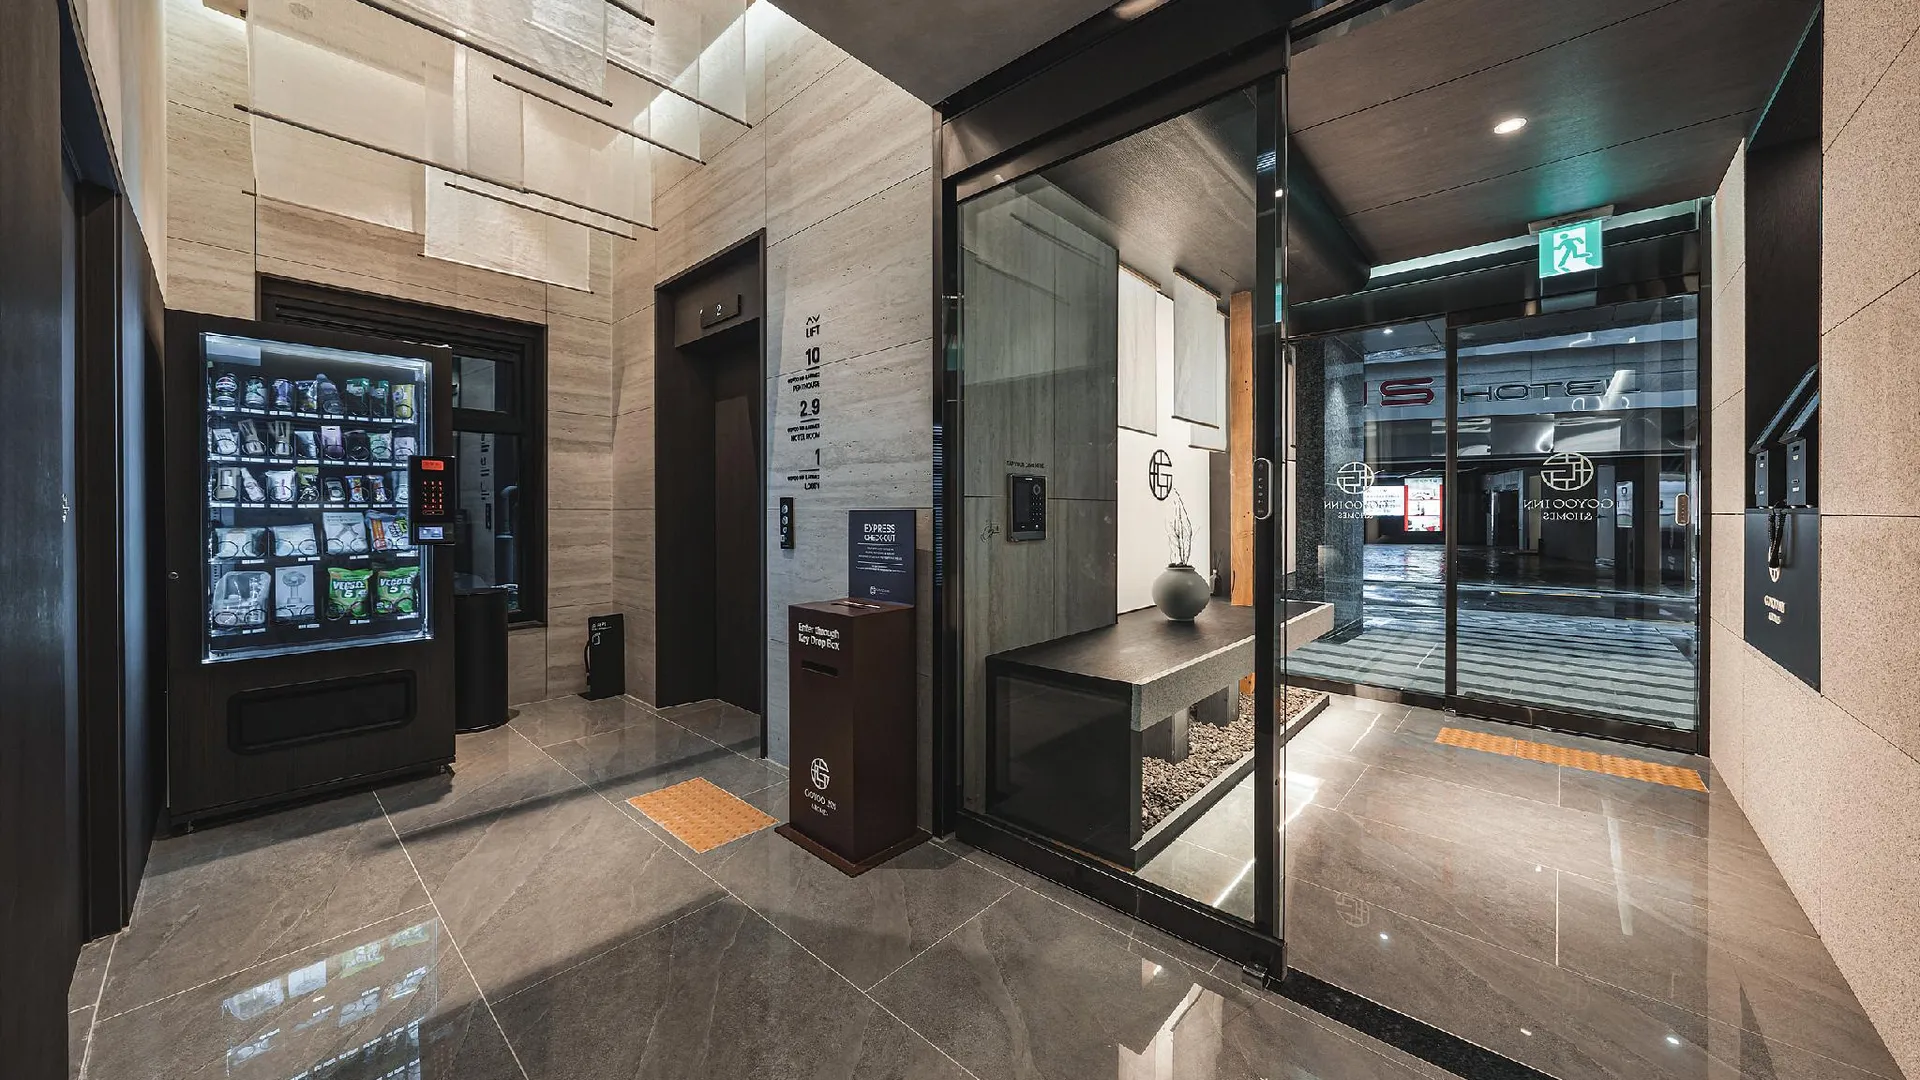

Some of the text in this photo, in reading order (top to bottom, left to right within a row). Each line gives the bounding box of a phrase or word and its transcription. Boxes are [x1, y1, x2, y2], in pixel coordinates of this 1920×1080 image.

[806, 325, 820, 338] LIFT
[805, 347, 820, 365] 10
[1459, 377, 1641, 404] HOTEL
[815, 448, 820, 465] 1
[864, 523, 896, 533] EXPRESS
[864, 534, 896, 542] CHECK-OUT
[798, 622, 840, 640] Enter through
[798, 633, 840, 651] Key Drop Box
